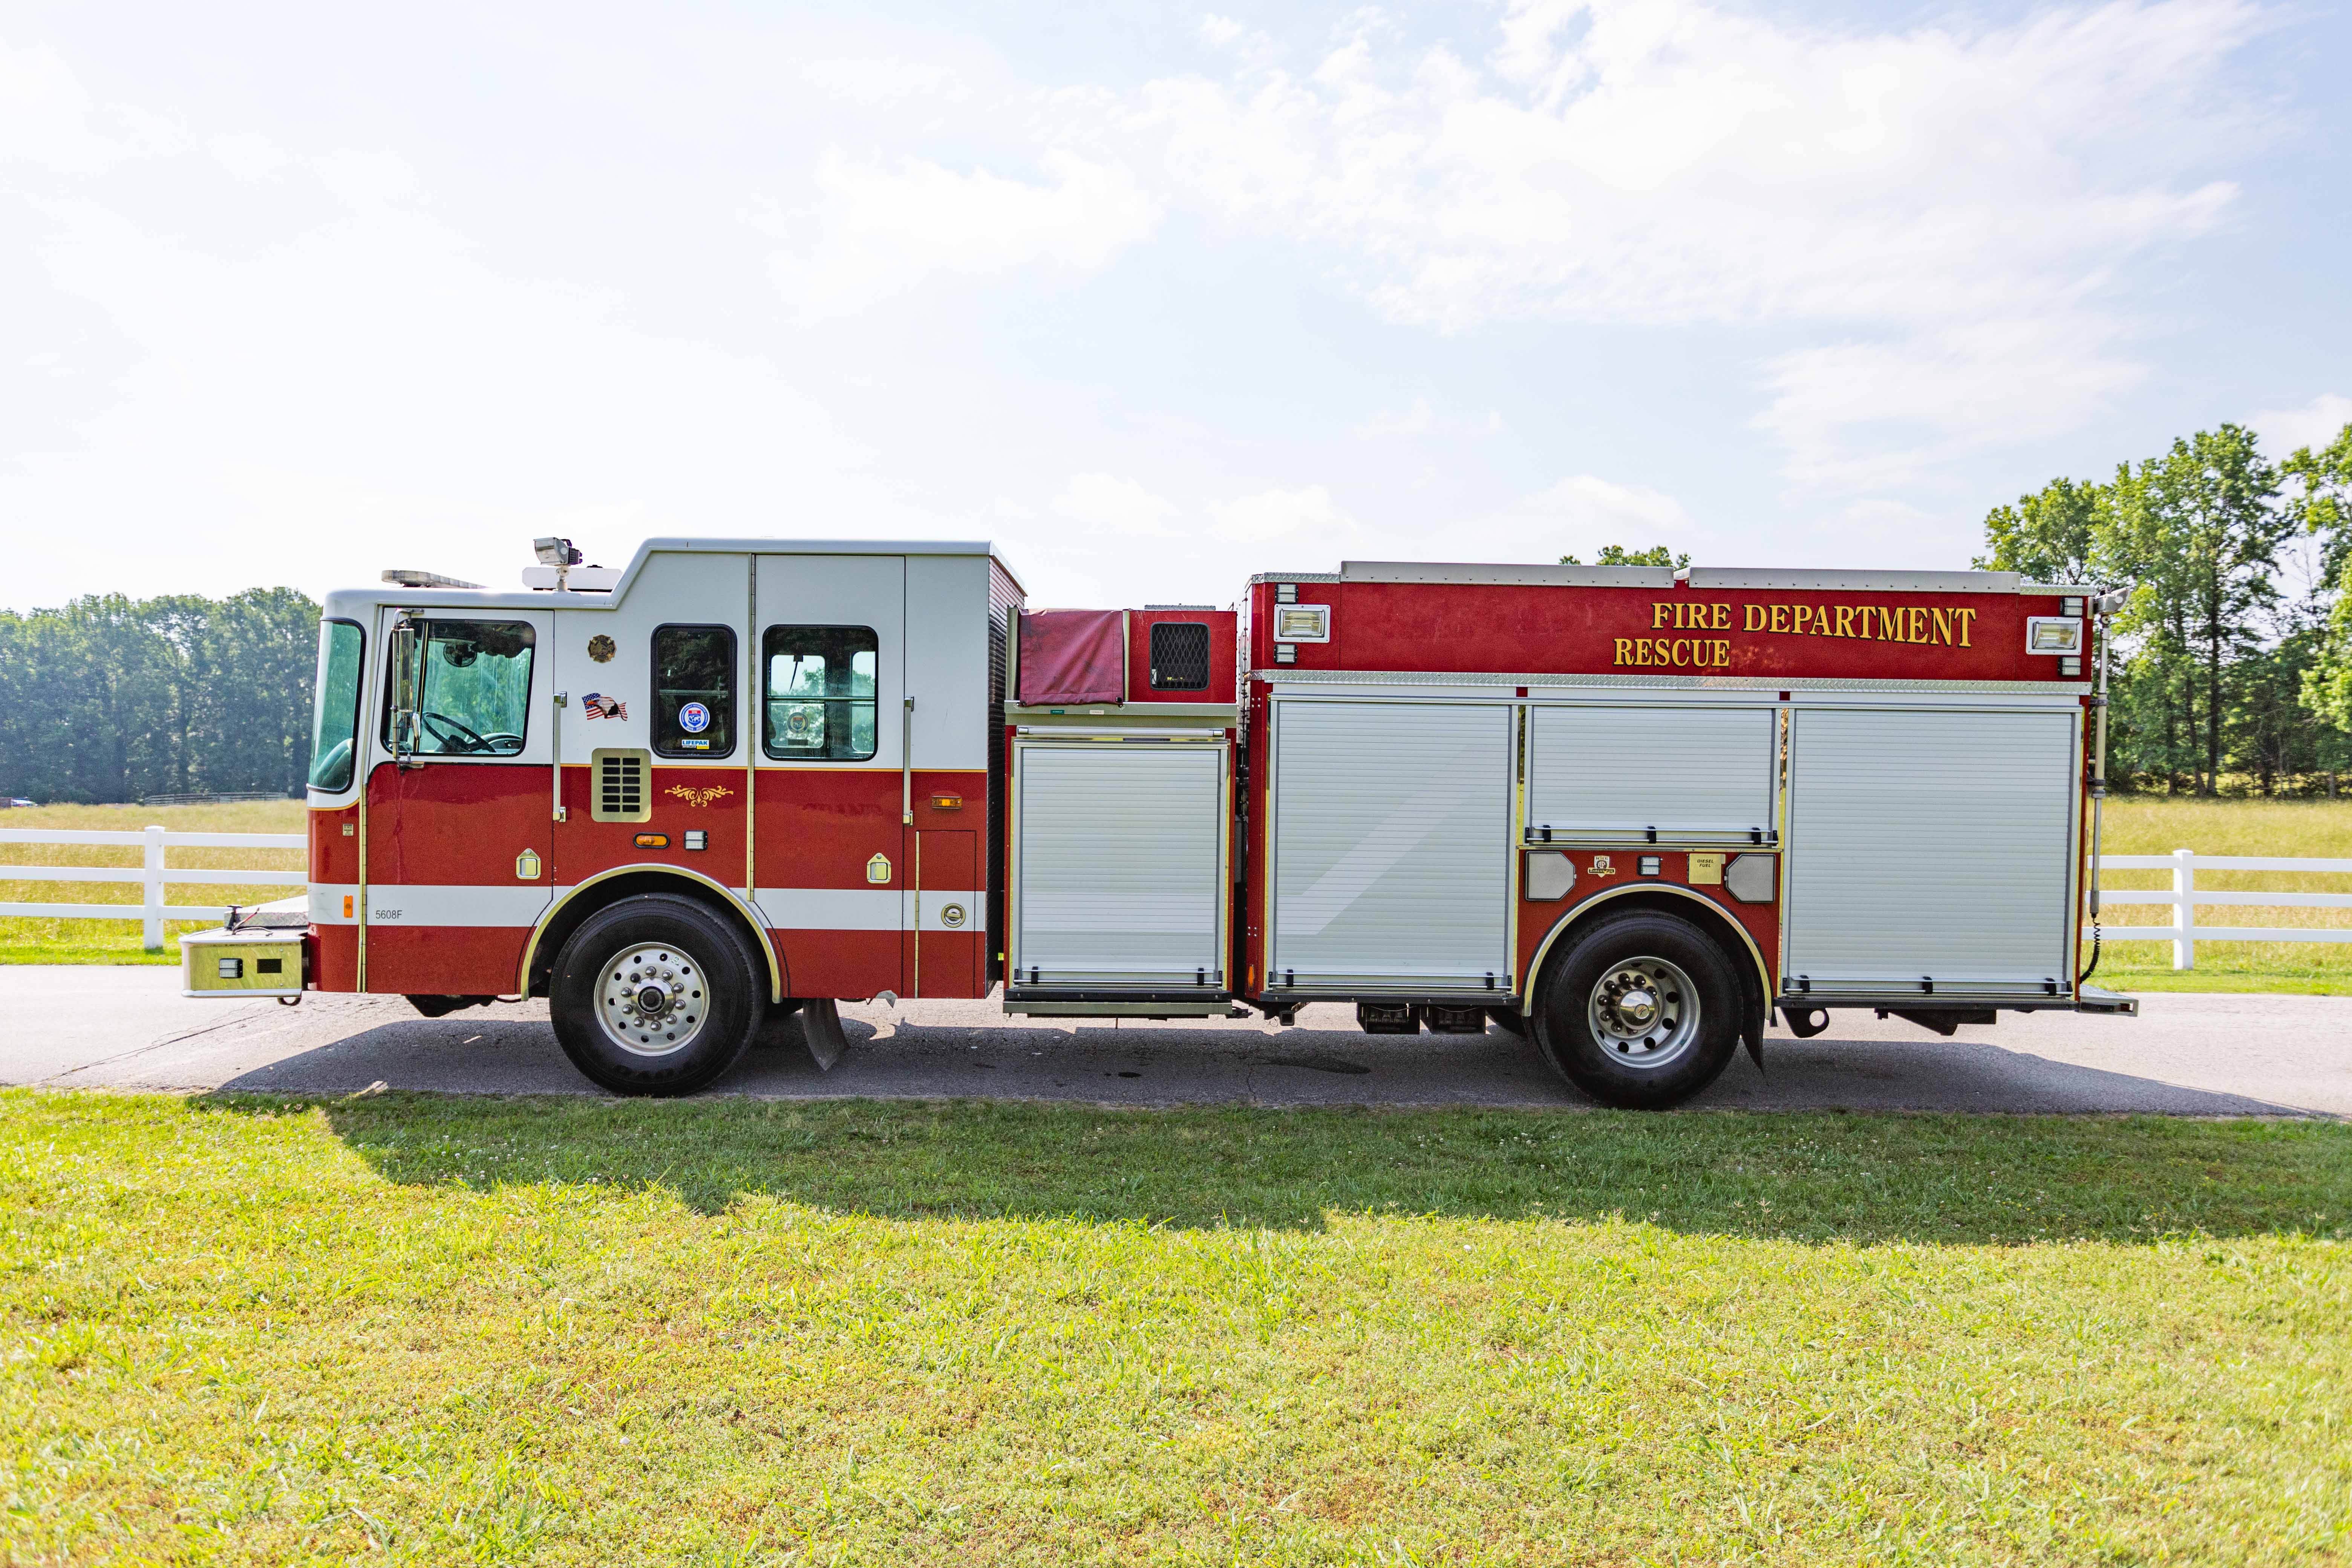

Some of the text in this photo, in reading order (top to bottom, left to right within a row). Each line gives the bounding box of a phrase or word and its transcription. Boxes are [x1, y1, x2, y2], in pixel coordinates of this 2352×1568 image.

[1651, 603, 1976, 648] FIRE DEPARTMENT
[1613, 639, 1729, 667] RESCUE
[376, 910, 402, 919] 5608F
